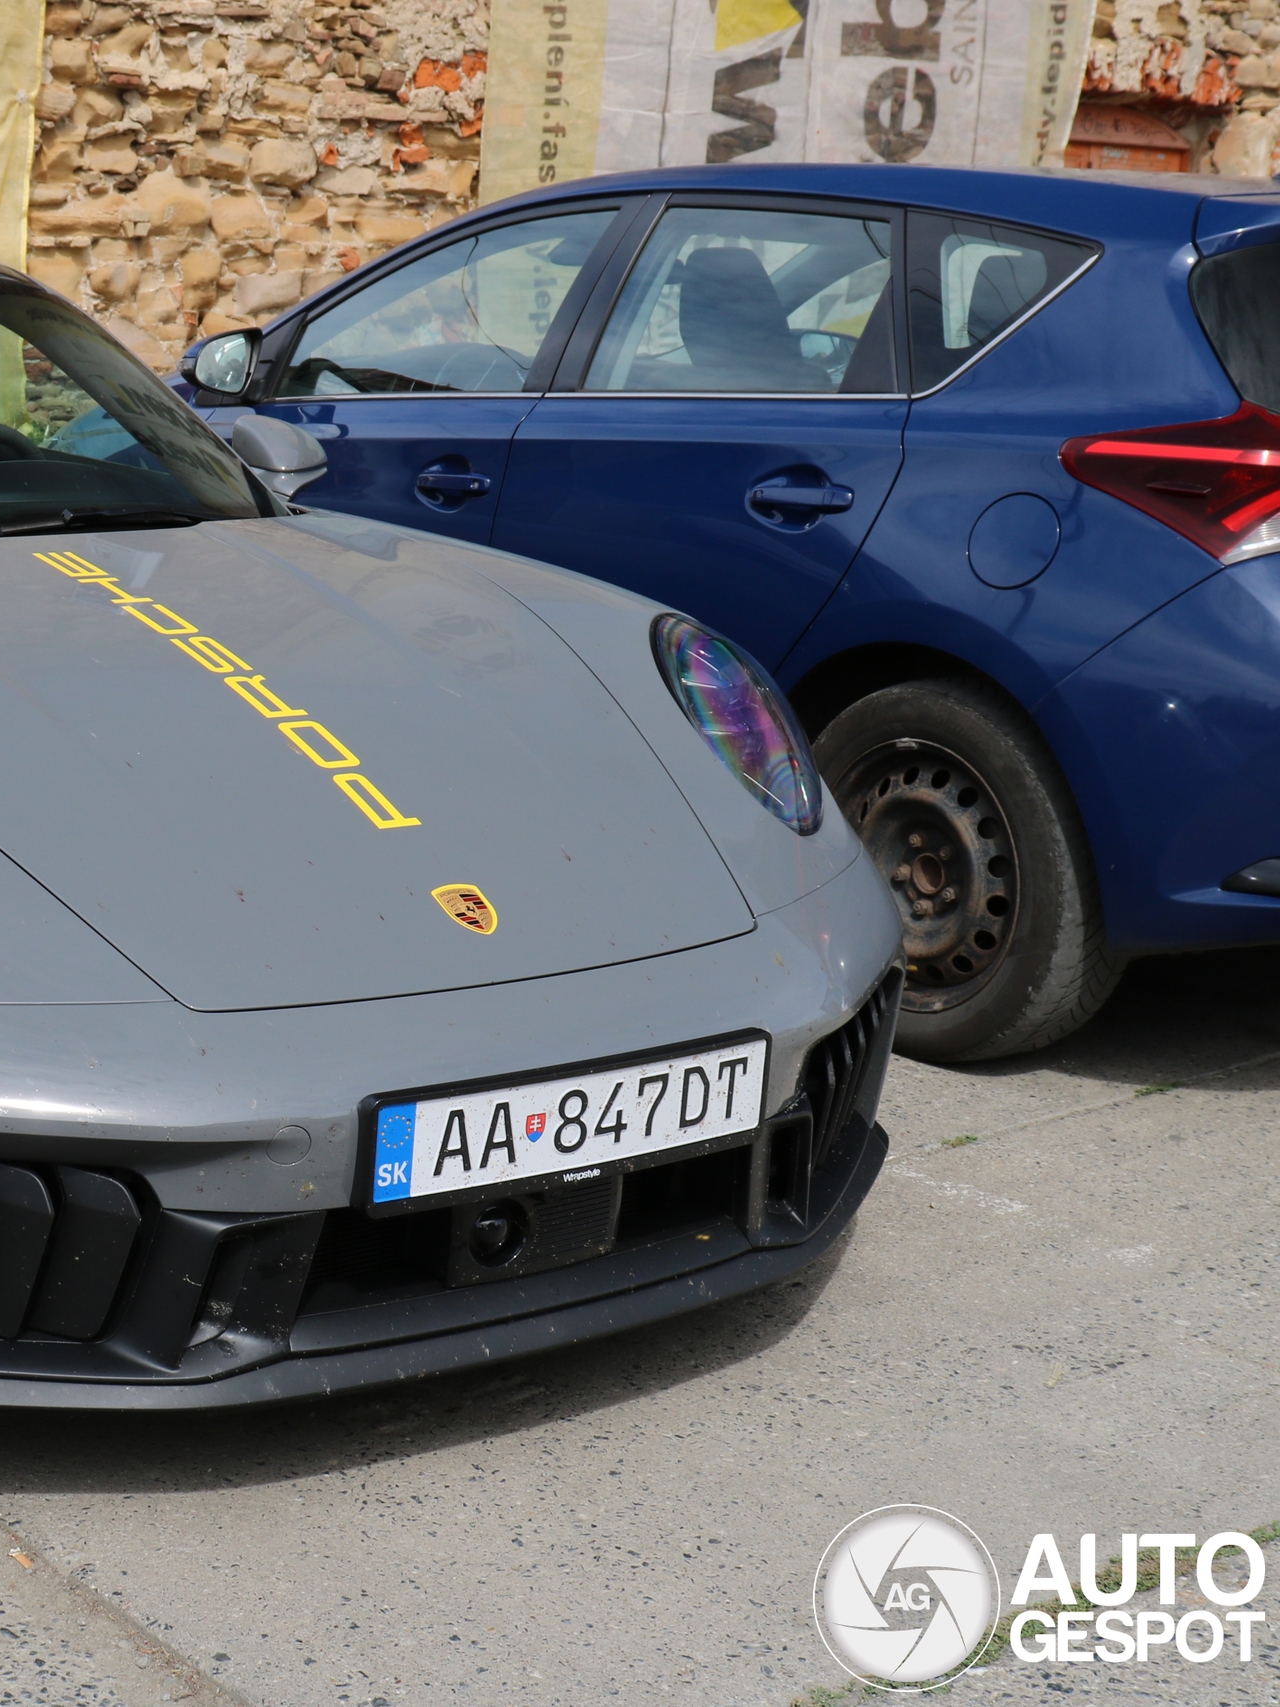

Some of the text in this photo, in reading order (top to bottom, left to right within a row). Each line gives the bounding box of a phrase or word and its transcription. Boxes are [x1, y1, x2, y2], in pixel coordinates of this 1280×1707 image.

[538, 0, 573, 183] plení.fas
[32, 551, 422, 830] PORSCHE
[378, 1161, 407, 1188] SK
[433, 1056, 748, 1176] AA 847DT
[563, 1168, 601, 1182] Wrapstyle
